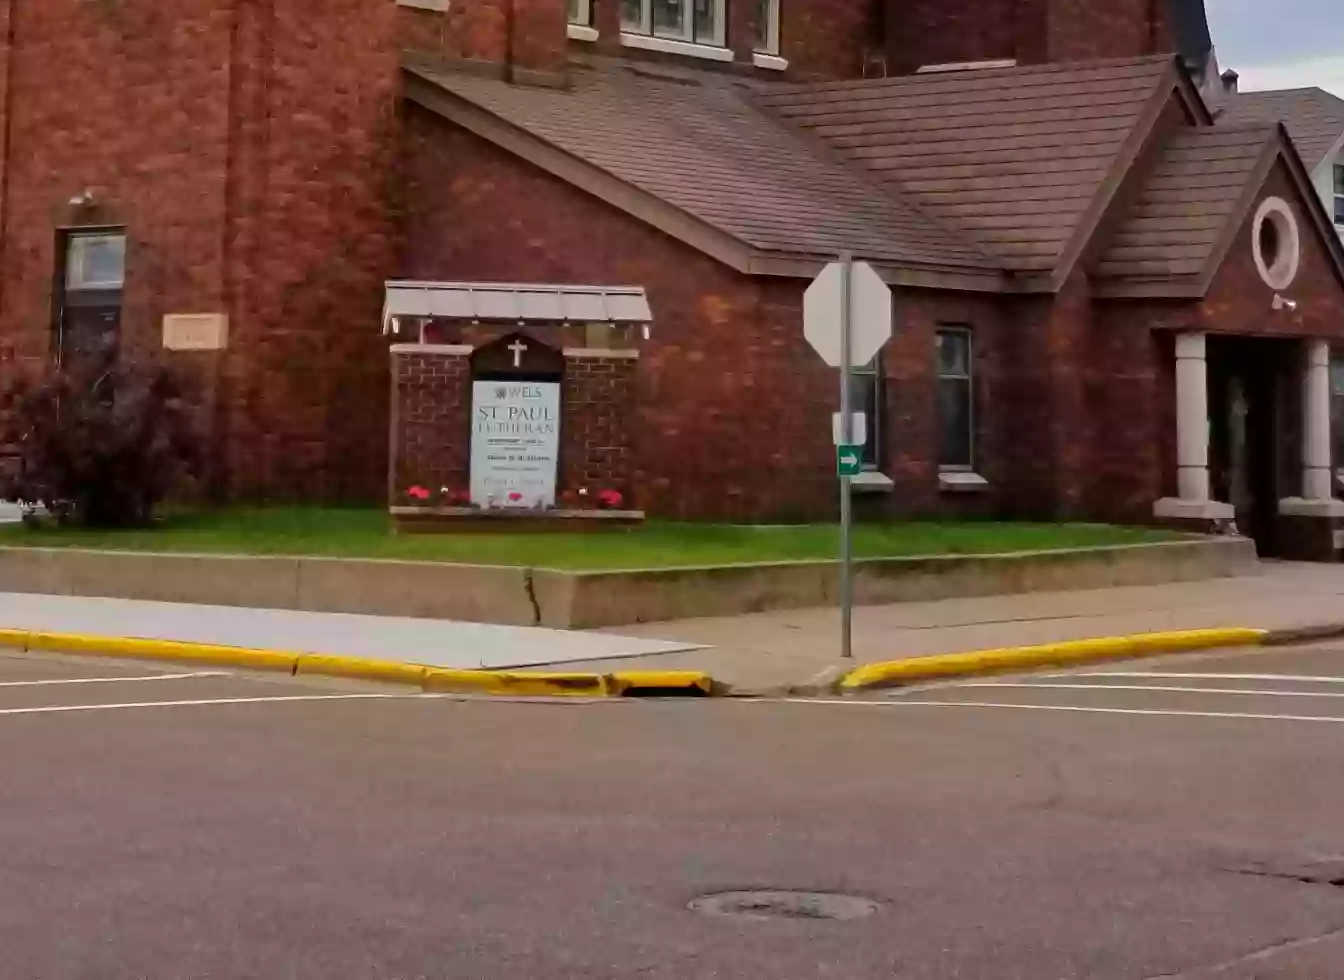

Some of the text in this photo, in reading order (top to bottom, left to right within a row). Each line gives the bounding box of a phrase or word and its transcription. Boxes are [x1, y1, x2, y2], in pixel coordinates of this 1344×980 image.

[508, 386, 542, 398] WELS
[479, 406, 554, 421] ST PAUL
[478, 422, 554, 434] LUTHERAN
